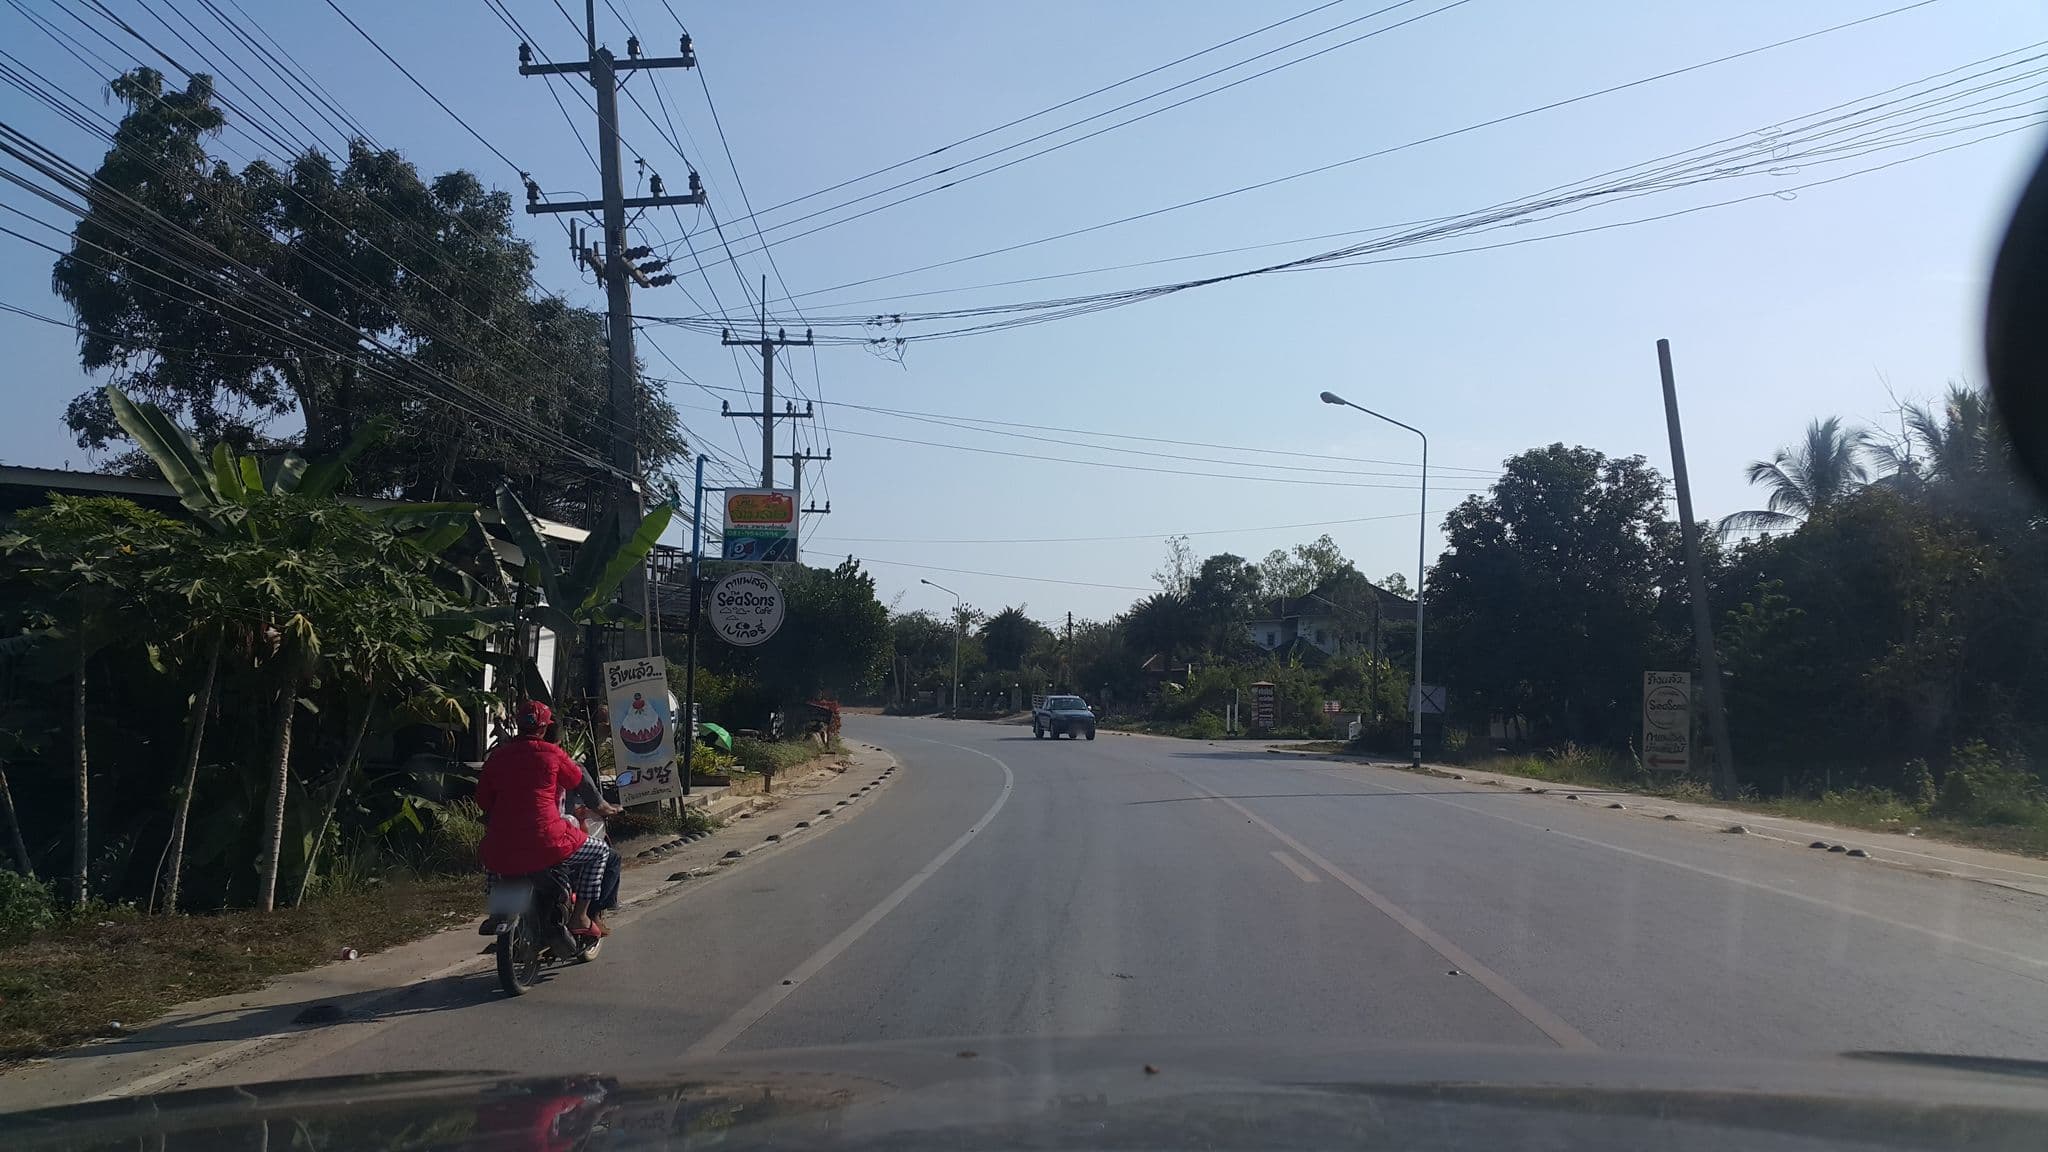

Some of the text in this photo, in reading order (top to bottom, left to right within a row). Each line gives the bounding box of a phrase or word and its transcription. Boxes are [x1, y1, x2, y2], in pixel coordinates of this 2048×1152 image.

[725, 576, 768, 591] กาแฟสด
[722, 619, 767, 639] เบเกอรี่
